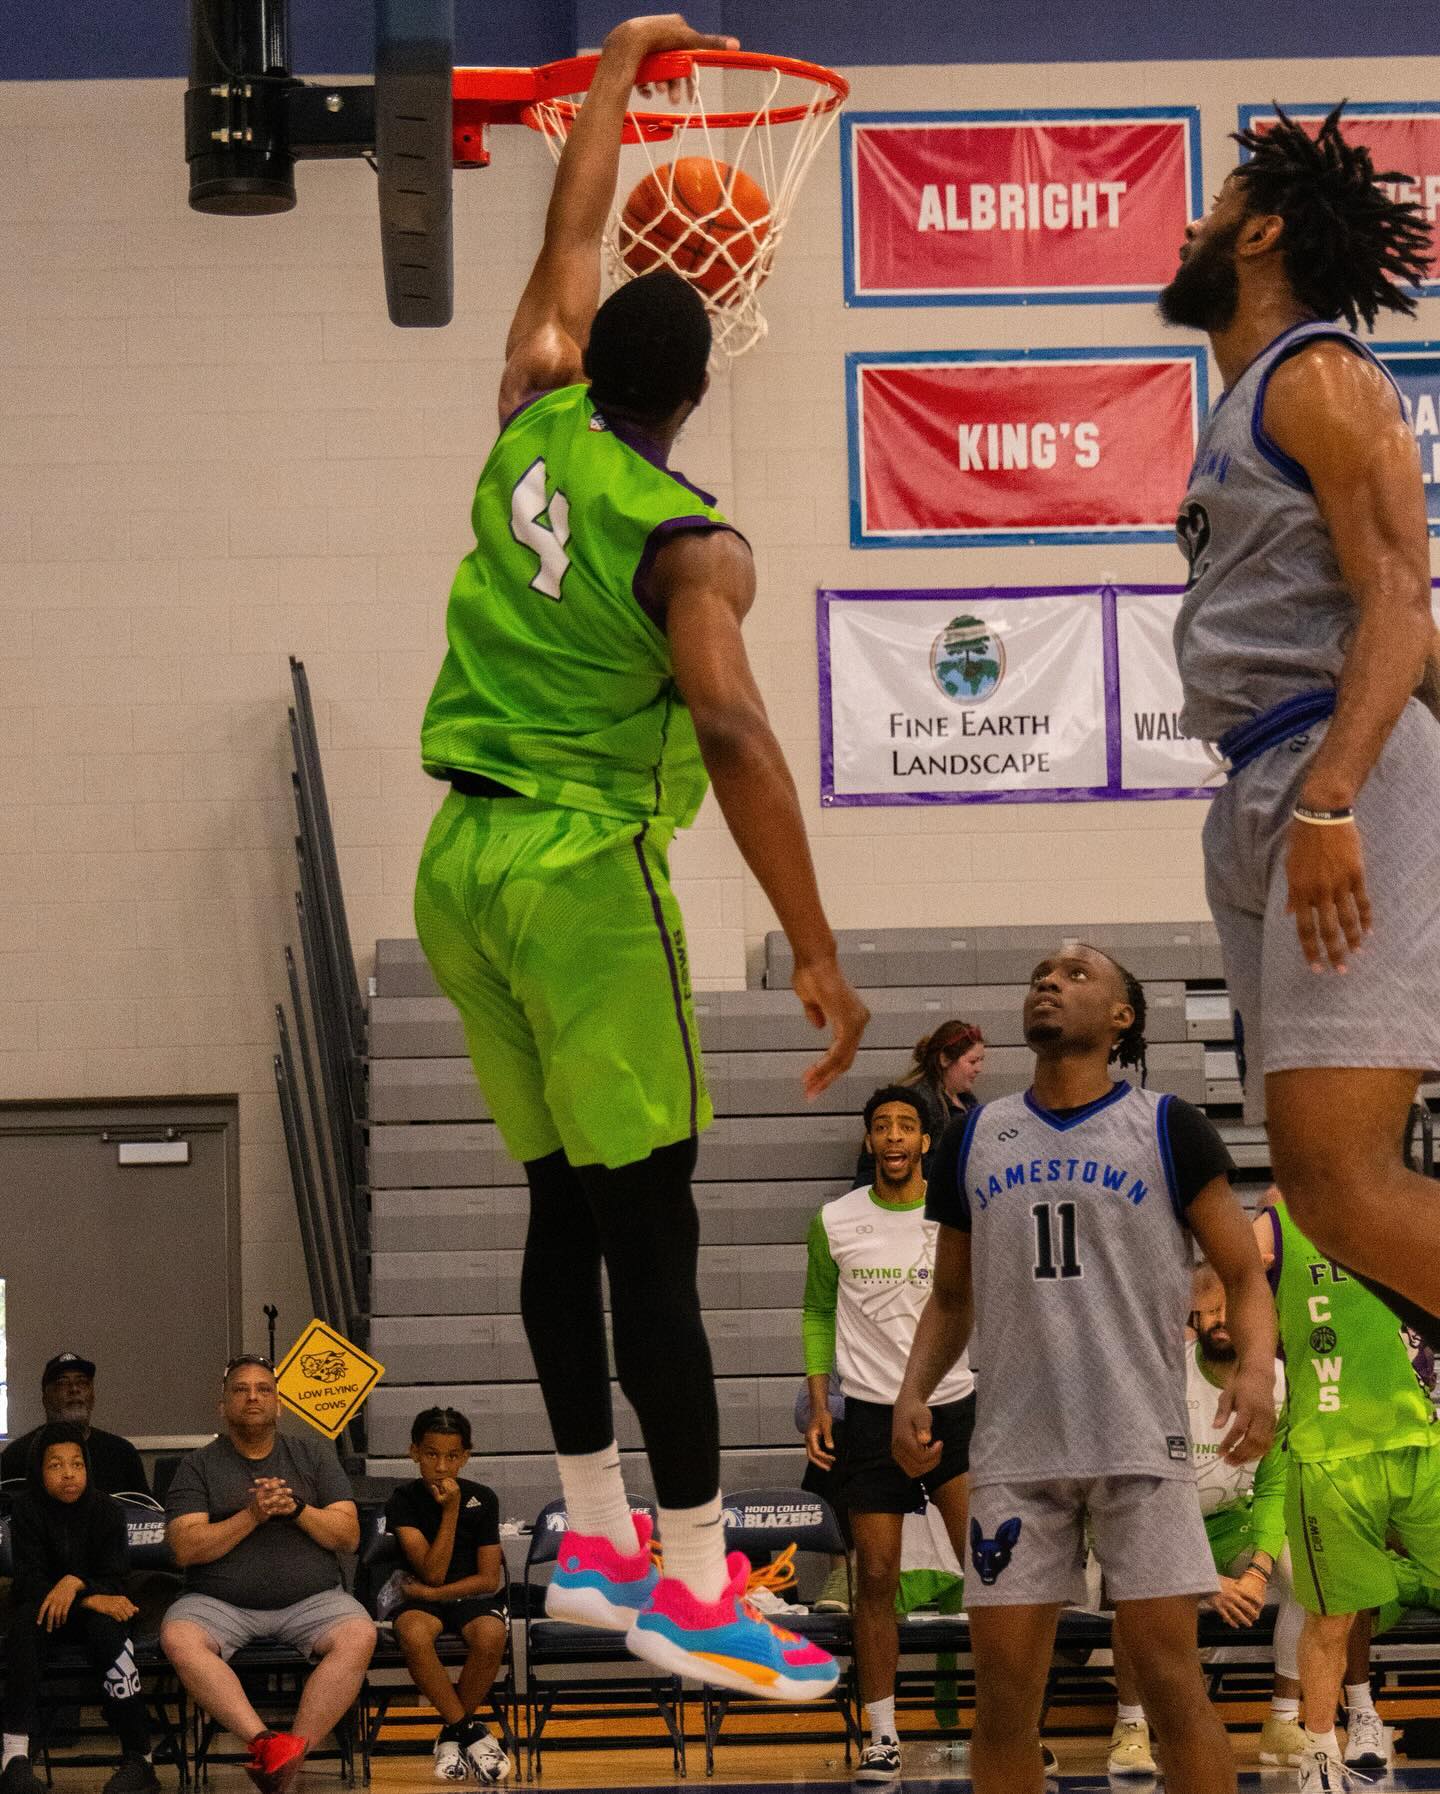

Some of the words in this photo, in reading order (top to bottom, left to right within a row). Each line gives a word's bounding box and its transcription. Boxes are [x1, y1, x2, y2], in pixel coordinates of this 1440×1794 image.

[918, 181, 1127, 232] ALBRIGHT
[958, 422, 1100, 471] KING'S
[509, 455, 572, 603] 4
[1134, 712, 1185, 740] WAL
[975, 1159, 1148, 1210] JAMESTOWN
[1030, 1201, 1084, 1281] 11
[851, 1268, 902, 1280] FLYING
[1307, 1261, 1350, 1287] FL
[298, 1389, 323, 1401] LOW
[324, 1383, 359, 1396] FLYING
[314, 1400, 346, 1412] COWS
[743, 1511, 823, 1528] BLAZERS
[744, 1505, 775, 1513] HOOD
[776, 1503, 822, 1512] COLLEGE
[127, 1522, 166, 1531] OLLEGE
